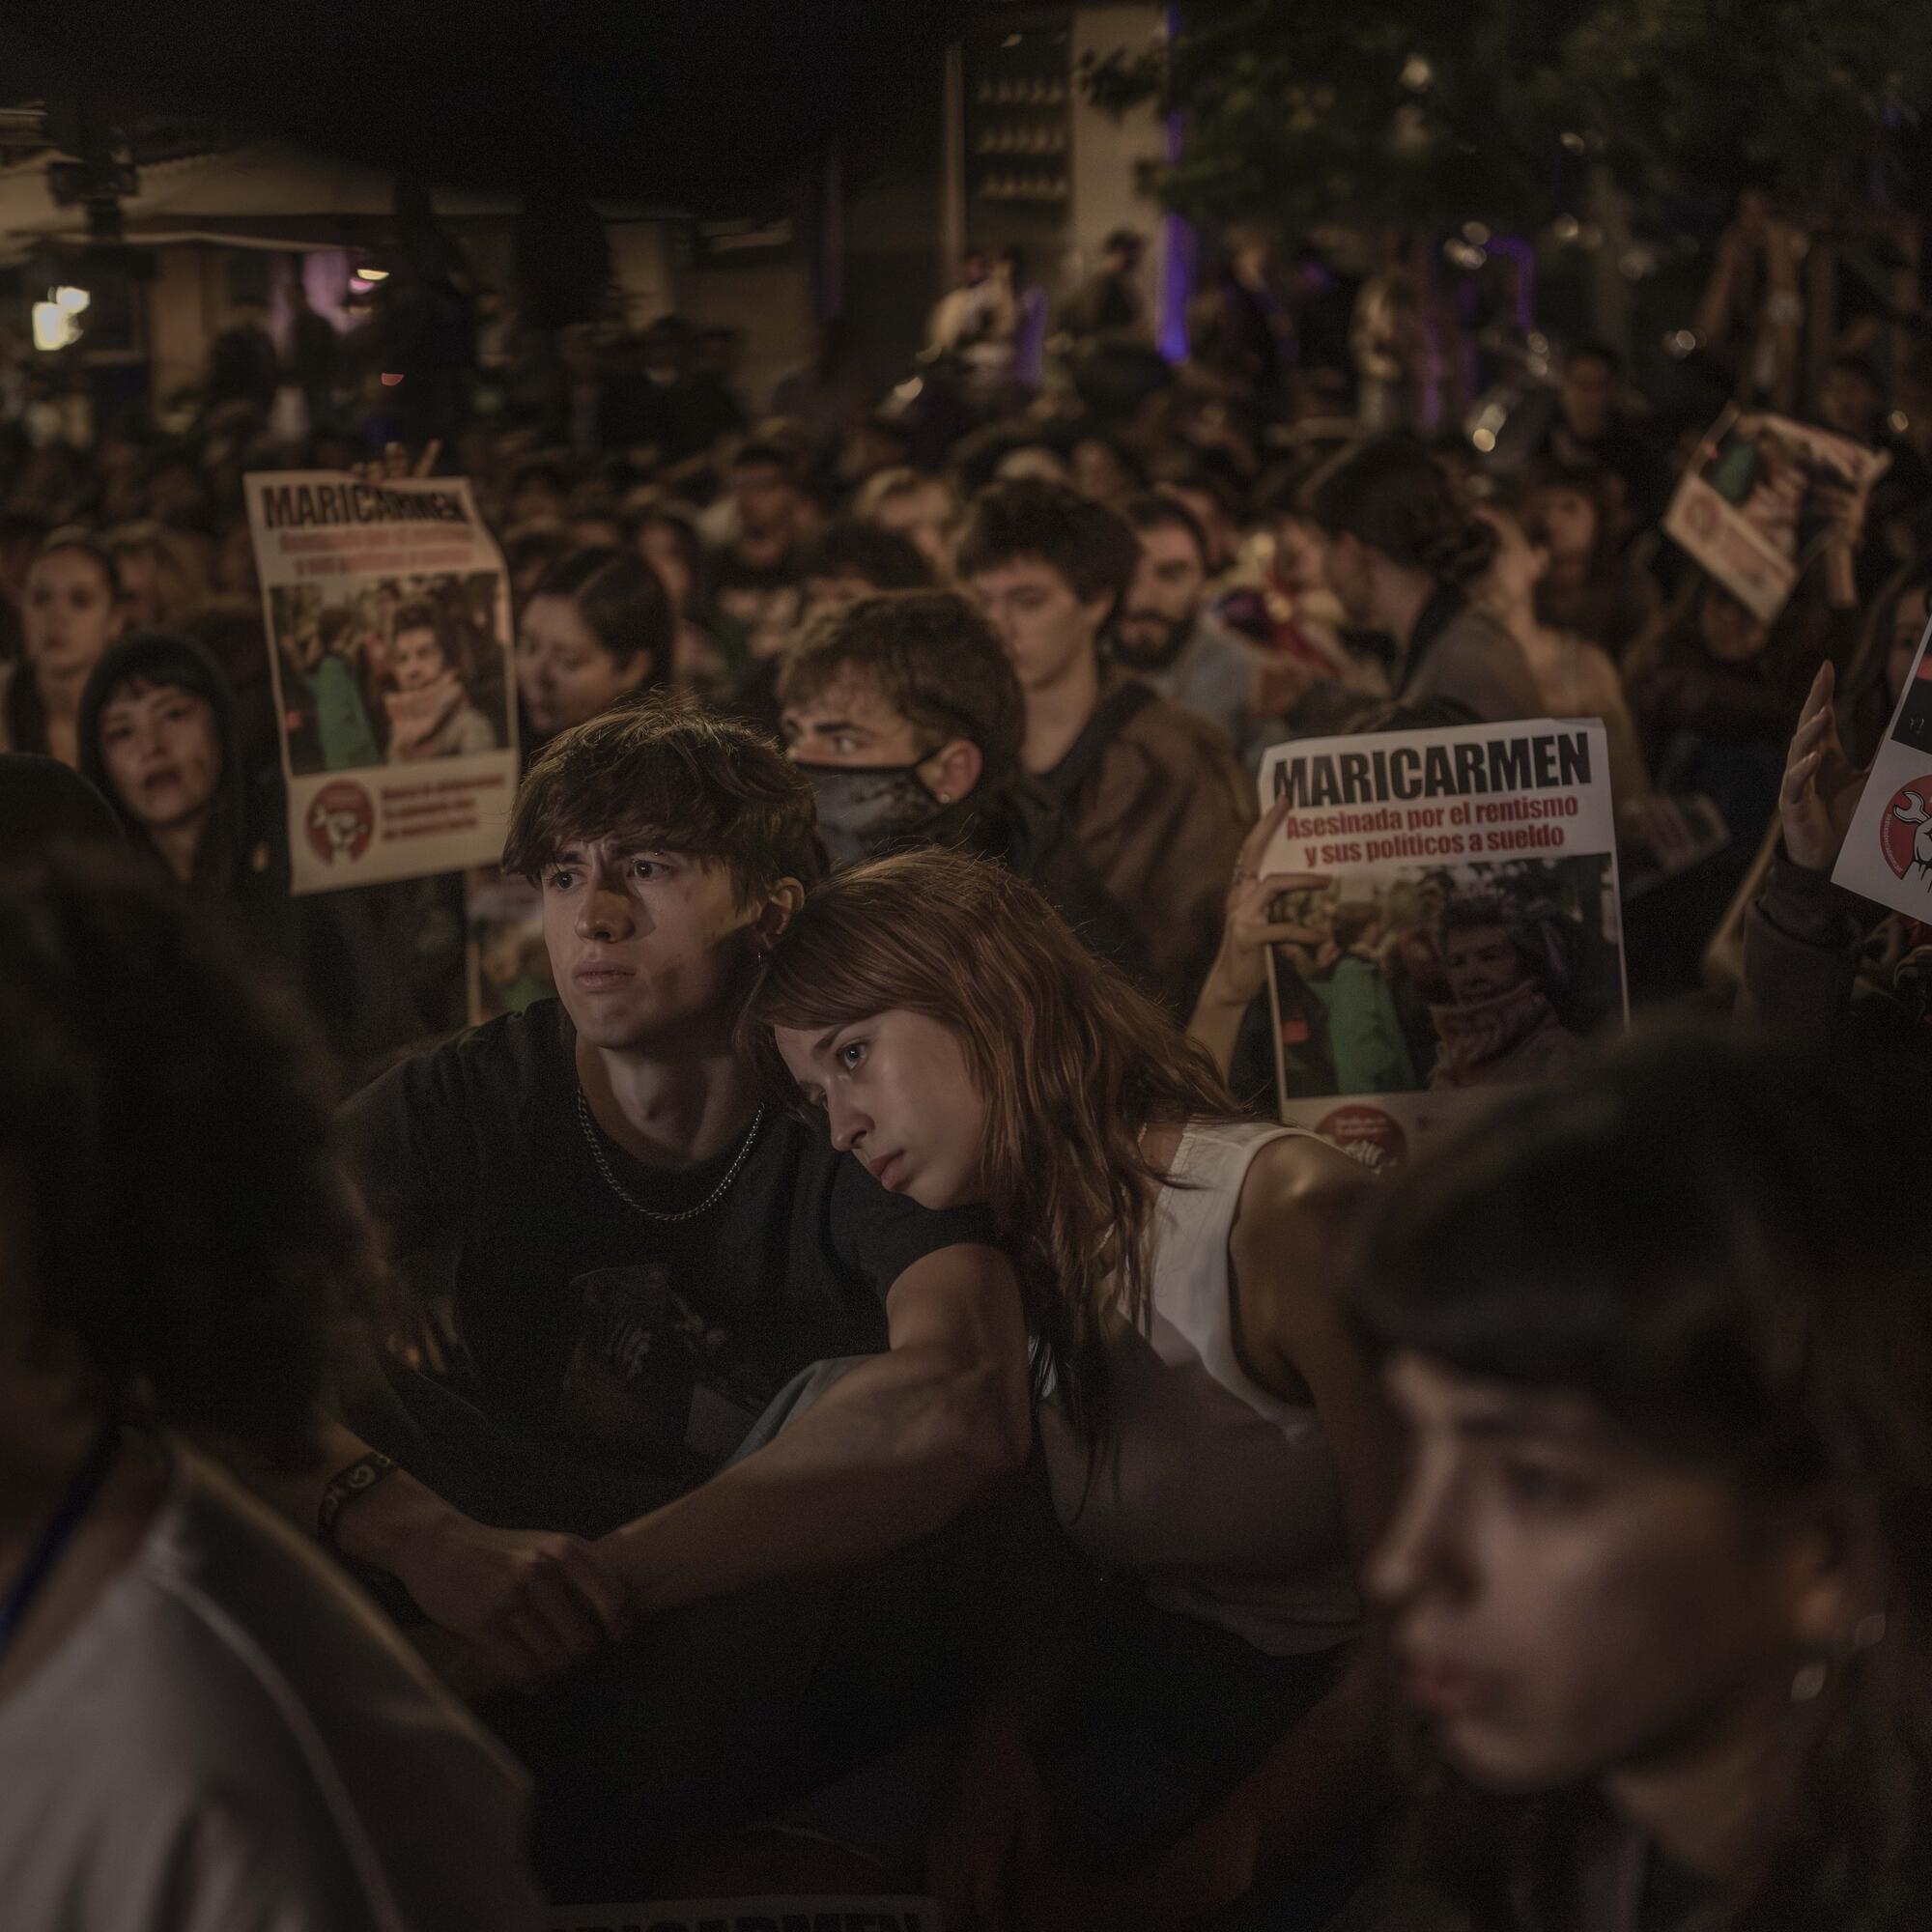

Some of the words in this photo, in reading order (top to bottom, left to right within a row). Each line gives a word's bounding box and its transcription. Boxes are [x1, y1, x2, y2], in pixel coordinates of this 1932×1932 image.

[1273, 732, 1592, 808] MARICARMEN
[1287, 809, 1403, 839] Asesinada
[1407, 806, 1445, 832] por
[1450, 802, 1471, 825] el
[1475, 796, 1578, 822] rentismo
[1304, 846, 1318, 867] y
[1321, 841, 1363, 864] sus
[1469, 834, 1484, 853] a
[1488, 824, 1565, 851] sueldo
